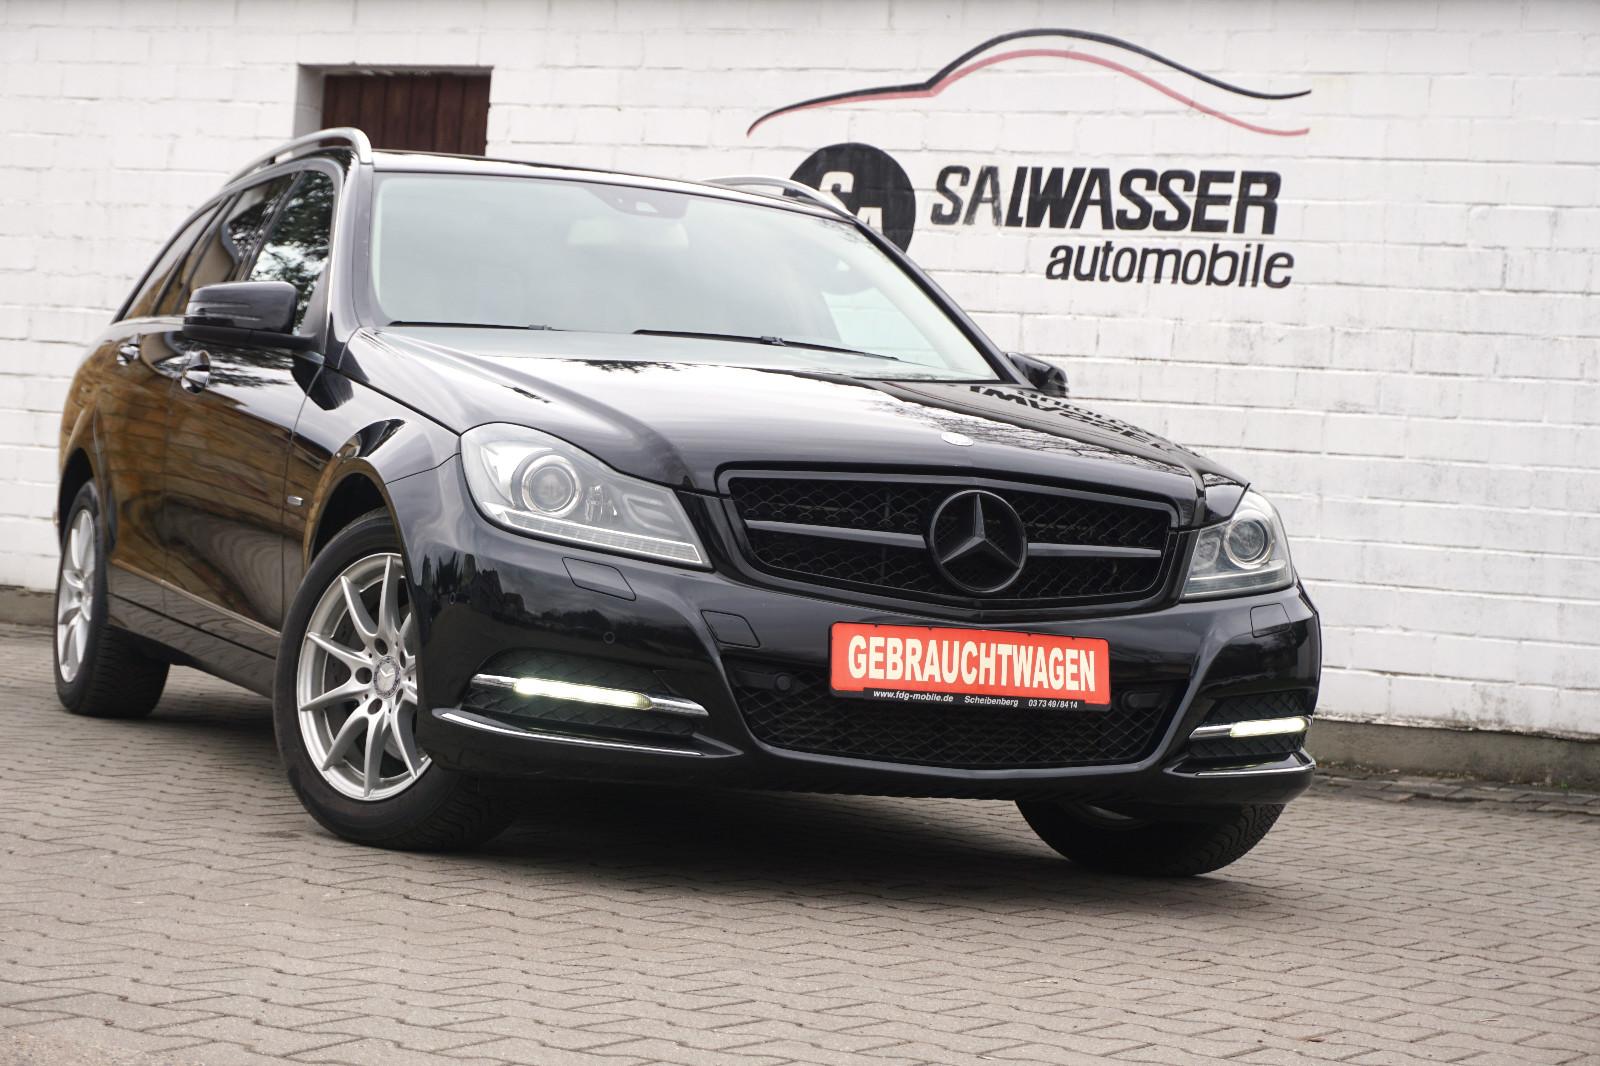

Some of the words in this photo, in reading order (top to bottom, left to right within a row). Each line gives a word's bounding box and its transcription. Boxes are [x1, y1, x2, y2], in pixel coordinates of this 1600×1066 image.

[930, 164, 1281, 235] SALWASSER
[1046, 241, 1294, 288] automobile
[848, 635, 1095, 692] GEBRAUCHTWAGEN
[873, 690, 954, 702] www.fdg-mobile.de
[964, 695, 1019, 707] Scheibenberg
